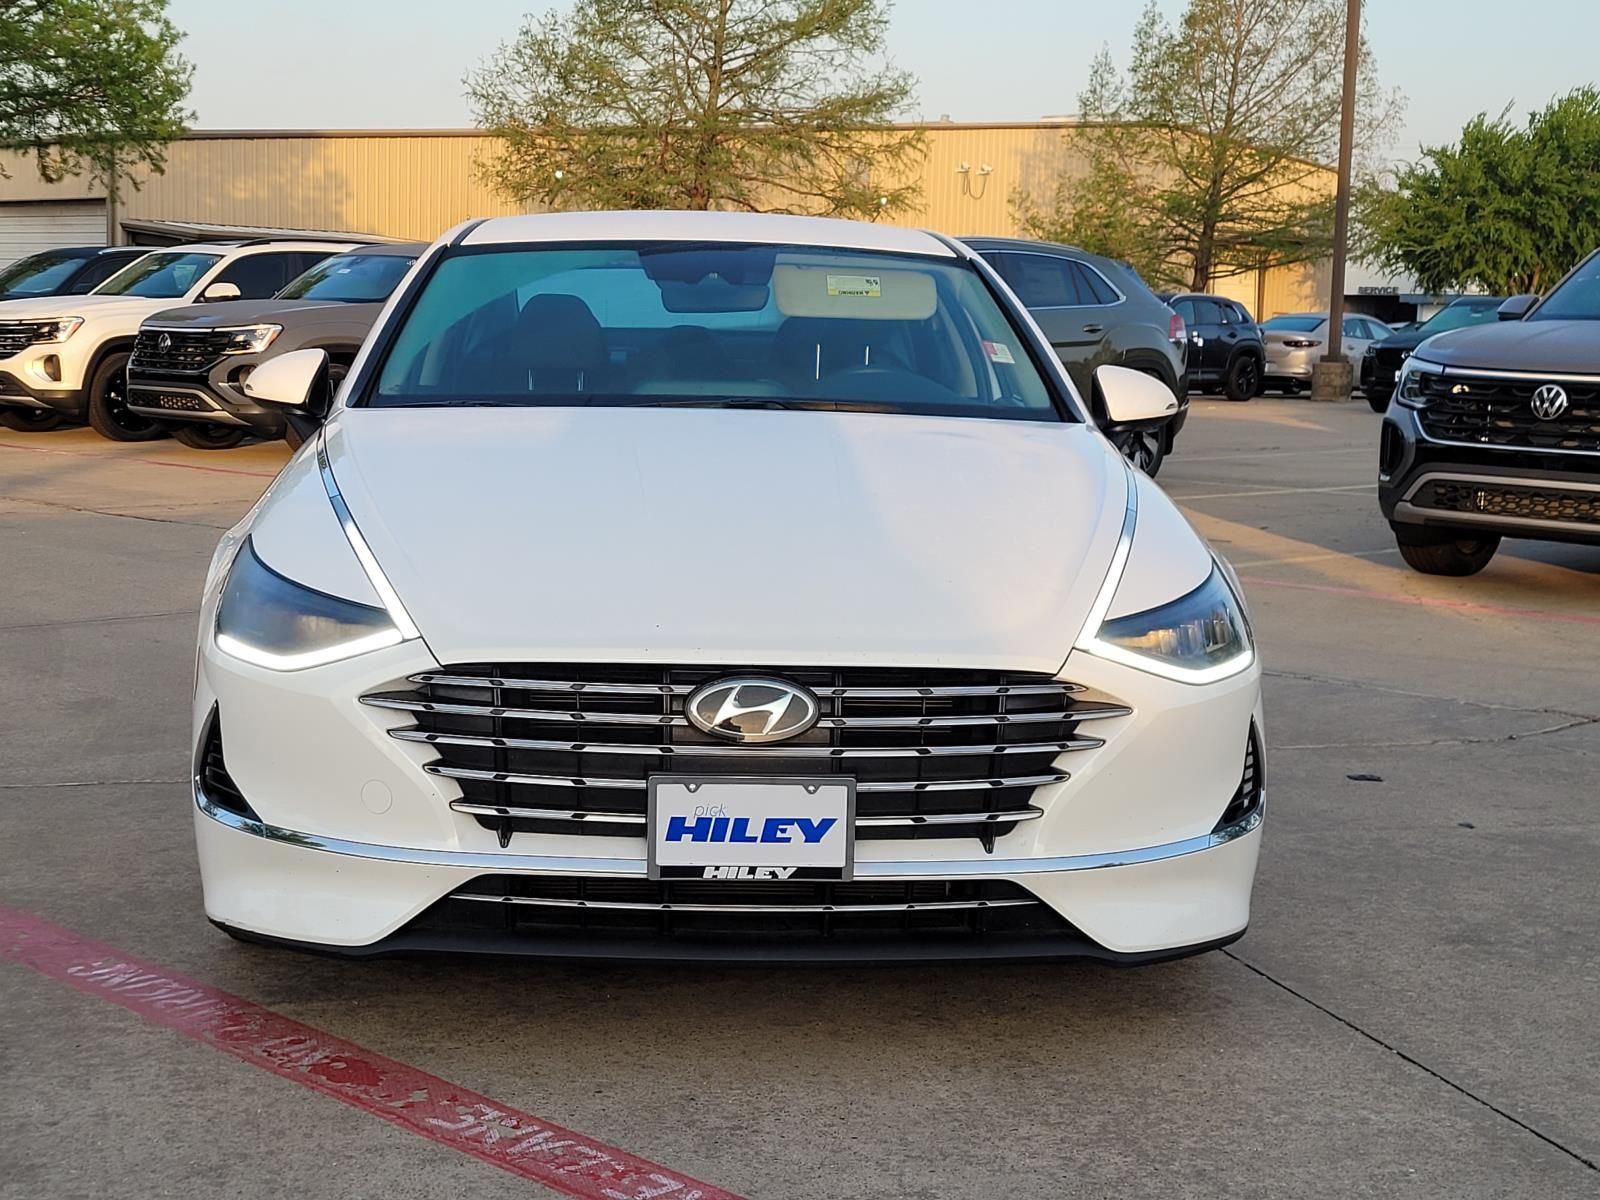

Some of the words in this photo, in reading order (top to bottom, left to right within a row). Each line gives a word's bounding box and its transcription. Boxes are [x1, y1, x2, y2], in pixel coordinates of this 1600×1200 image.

[1358, 286, 1399, 295] SERVICE
[693, 803, 728, 817] pick
[665, 816, 838, 843] HILEY
[702, 866, 797, 880] HILEY
